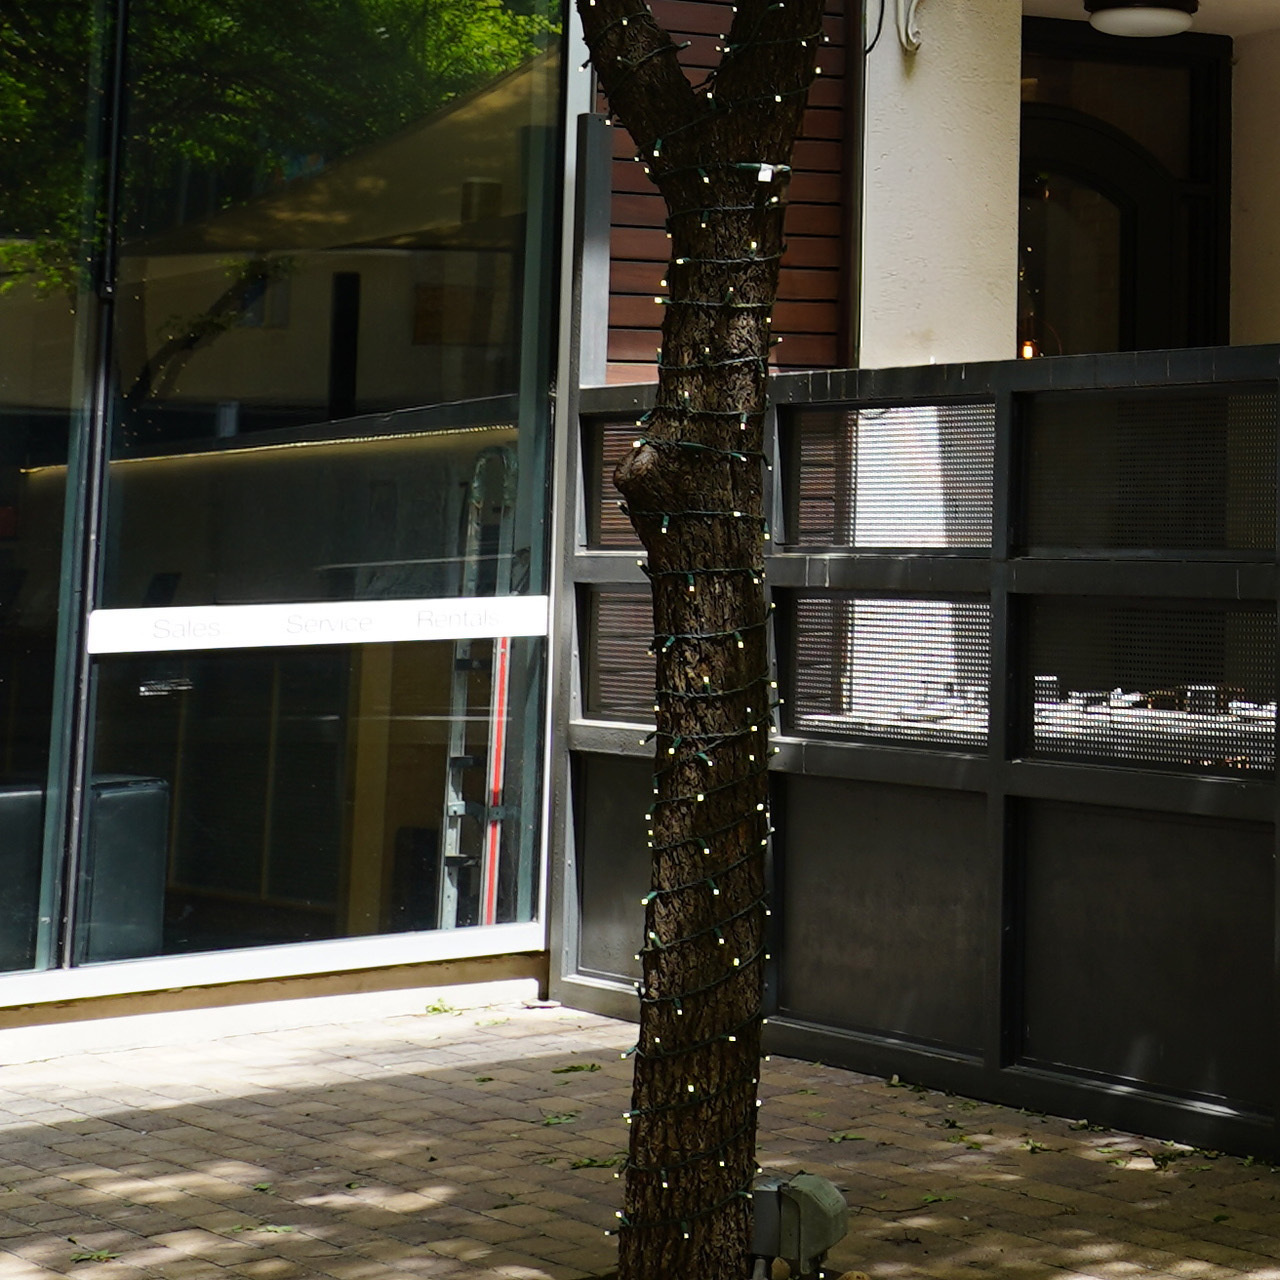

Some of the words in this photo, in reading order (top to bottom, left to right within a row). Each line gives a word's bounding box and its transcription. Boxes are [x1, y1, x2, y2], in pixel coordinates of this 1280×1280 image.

[153, 618, 221, 639] Sales
[286, 613, 373, 634] Service
[416, 607, 500, 628] Rentals
